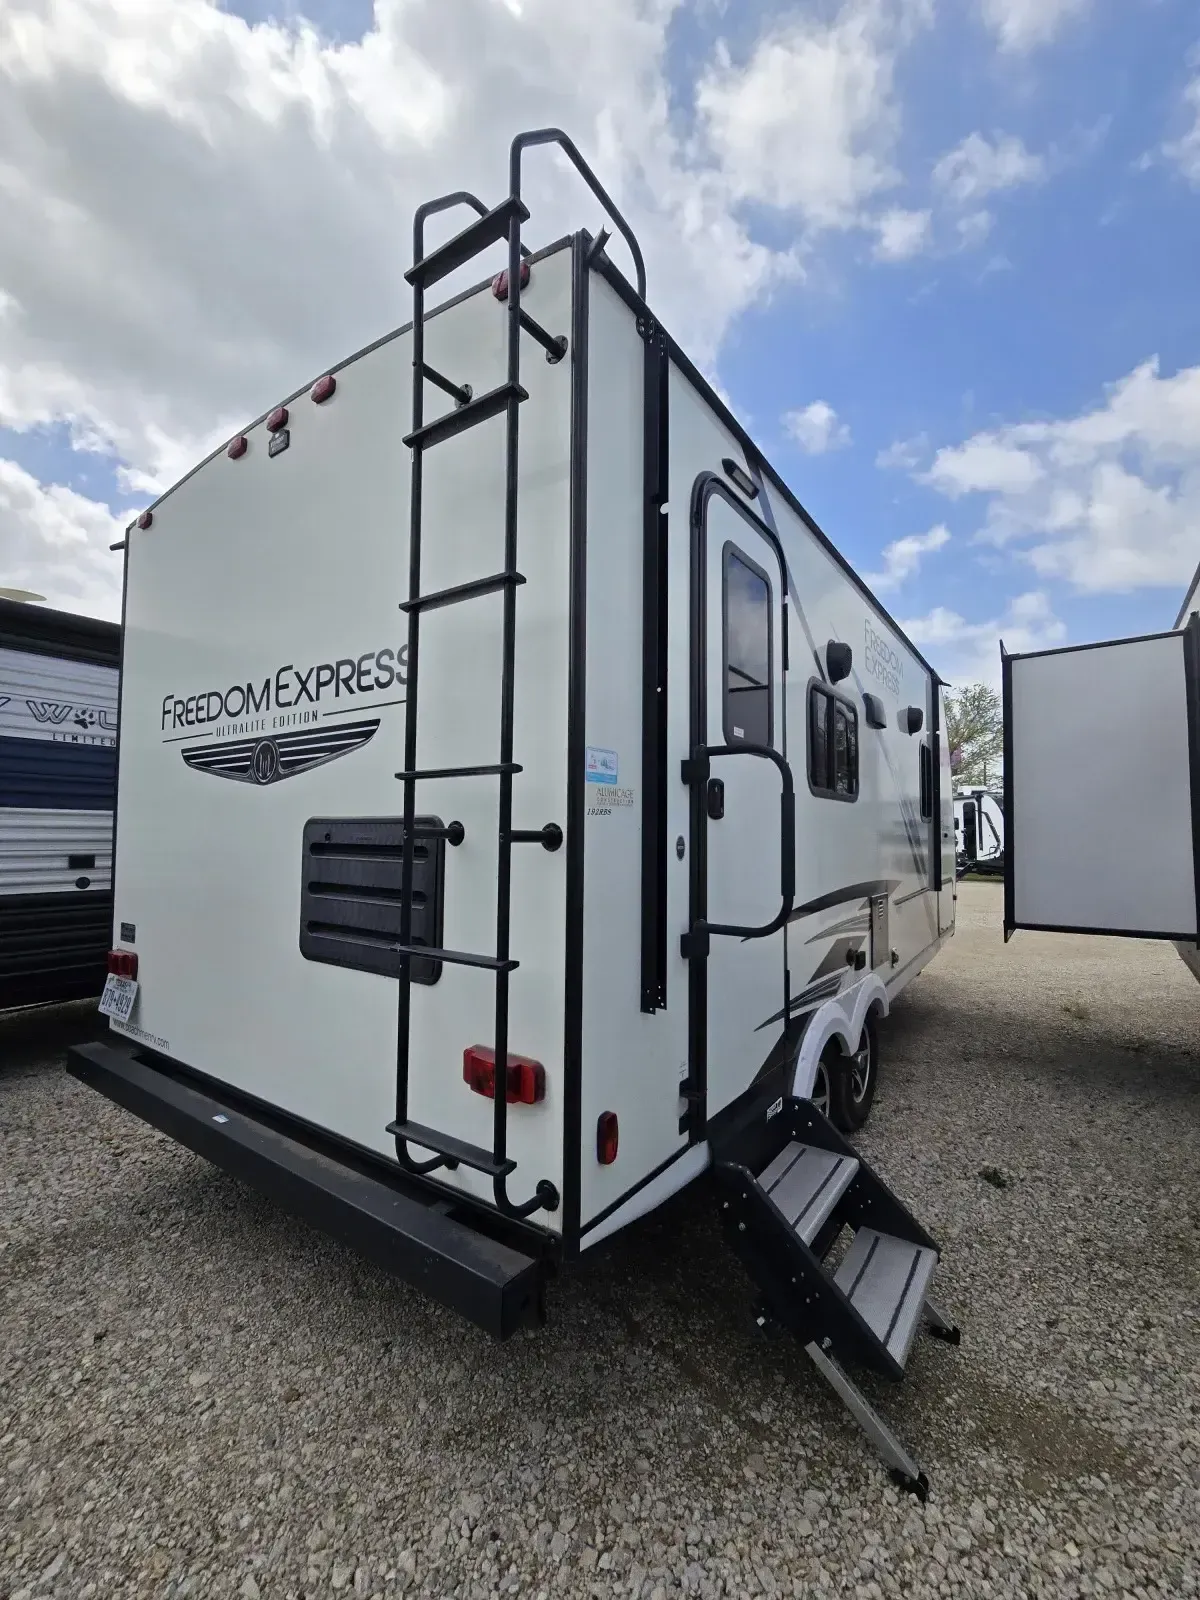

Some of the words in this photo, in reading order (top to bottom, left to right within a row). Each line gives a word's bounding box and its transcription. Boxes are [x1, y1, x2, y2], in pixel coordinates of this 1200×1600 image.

[865, 617, 904, 680] FREEDOM
[865, 646, 900, 695] EXPRESS
[161, 677, 271, 731] FREEDOM
[52, 732, 117, 747] LIMITED
[216, 718, 266, 737] ULTRALITE
[272, 710, 319, 729] EDITION
[596, 787, 634, 799] ALUMICAGE
